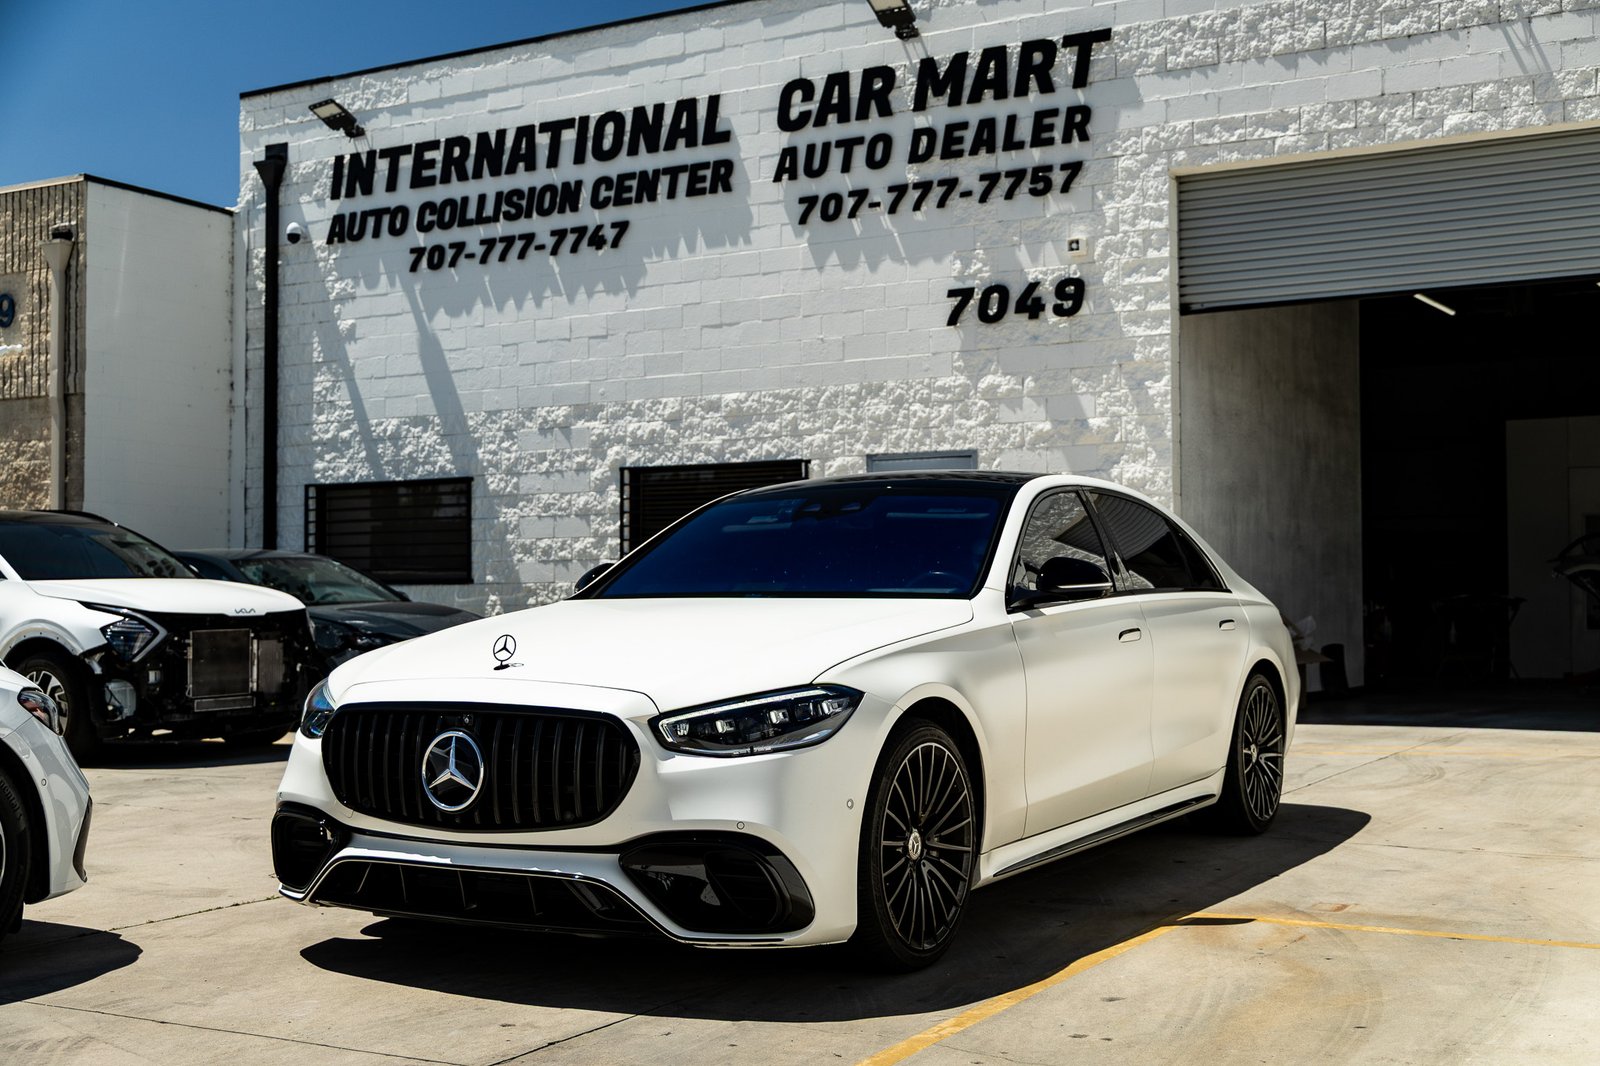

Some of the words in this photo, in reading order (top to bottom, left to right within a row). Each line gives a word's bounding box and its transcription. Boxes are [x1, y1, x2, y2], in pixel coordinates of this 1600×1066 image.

[777, 65, 897, 133] CAR
[912, 27, 1112, 112] MART
[330, 94, 732, 200] INTERNATIONAL
[772, 132, 894, 183] AUTO
[907, 104, 1092, 165] DEALER
[326, 205, 409, 245] AUTO
[415, 179, 583, 233] COLLISION
[590, 159, 735, 210] CENTER
[798, 160, 1084, 226] 707-777-7757
[408, 221, 630, 273] 707-777-7747
[946, 277, 1086, 327] 7049
